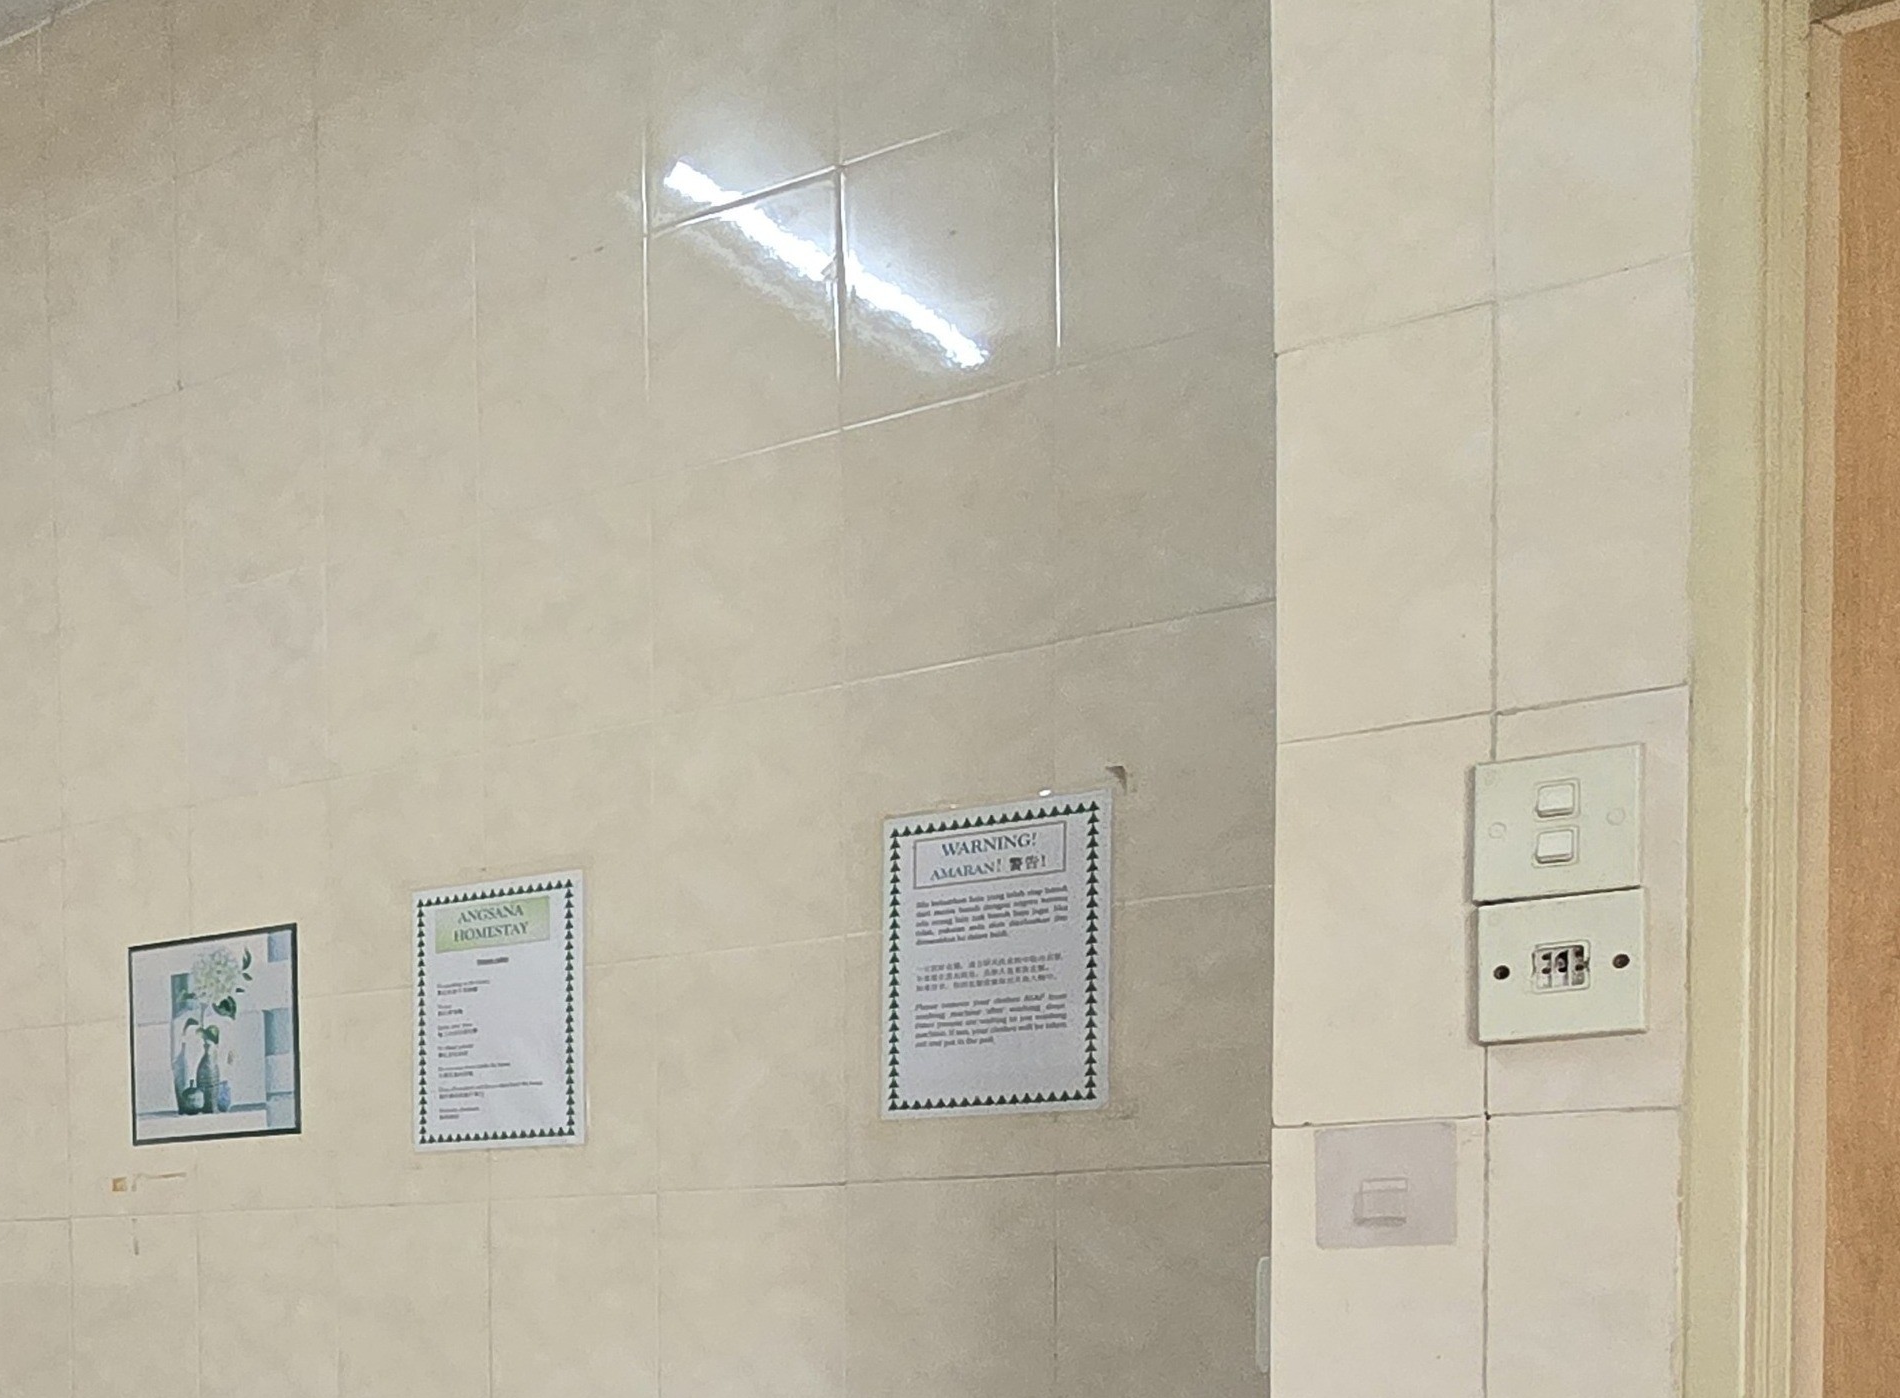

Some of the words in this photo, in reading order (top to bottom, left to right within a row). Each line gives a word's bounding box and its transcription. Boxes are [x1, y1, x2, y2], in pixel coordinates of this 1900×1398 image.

[941, 832, 1038, 857] WARNING!
[930, 858, 1002, 881] AMARAN!
[457, 904, 524, 925] ANGSANA
[453, 921, 529, 943] HOMESTAY
